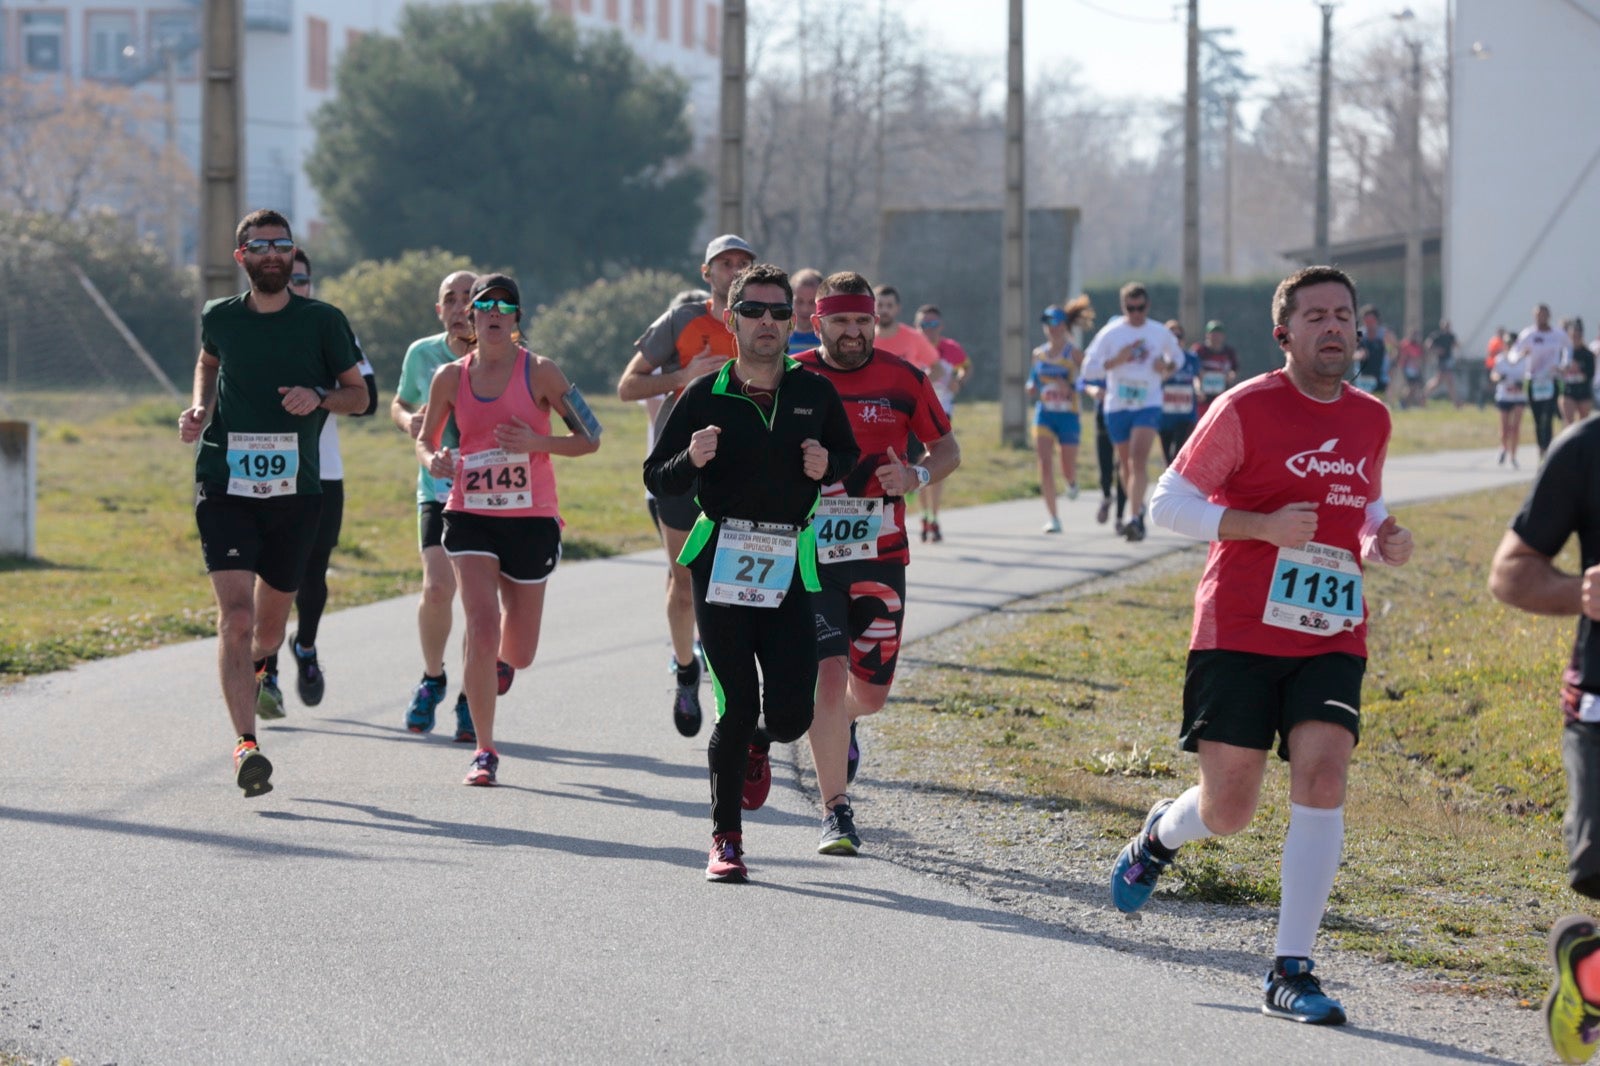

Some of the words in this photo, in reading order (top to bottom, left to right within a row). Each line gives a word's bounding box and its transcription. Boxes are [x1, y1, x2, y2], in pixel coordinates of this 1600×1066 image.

[239, 454, 286, 478] 199
[1306, 456, 1355, 477] Apolo
[466, 466, 527, 491] 2143
[1328, 484, 1351, 493] TEAM
[752, 534, 771, 544] PREMIO
[818, 519, 869, 543] 406
[735, 555, 775, 584] 27
[1281, 567, 1355, 611] 1131
